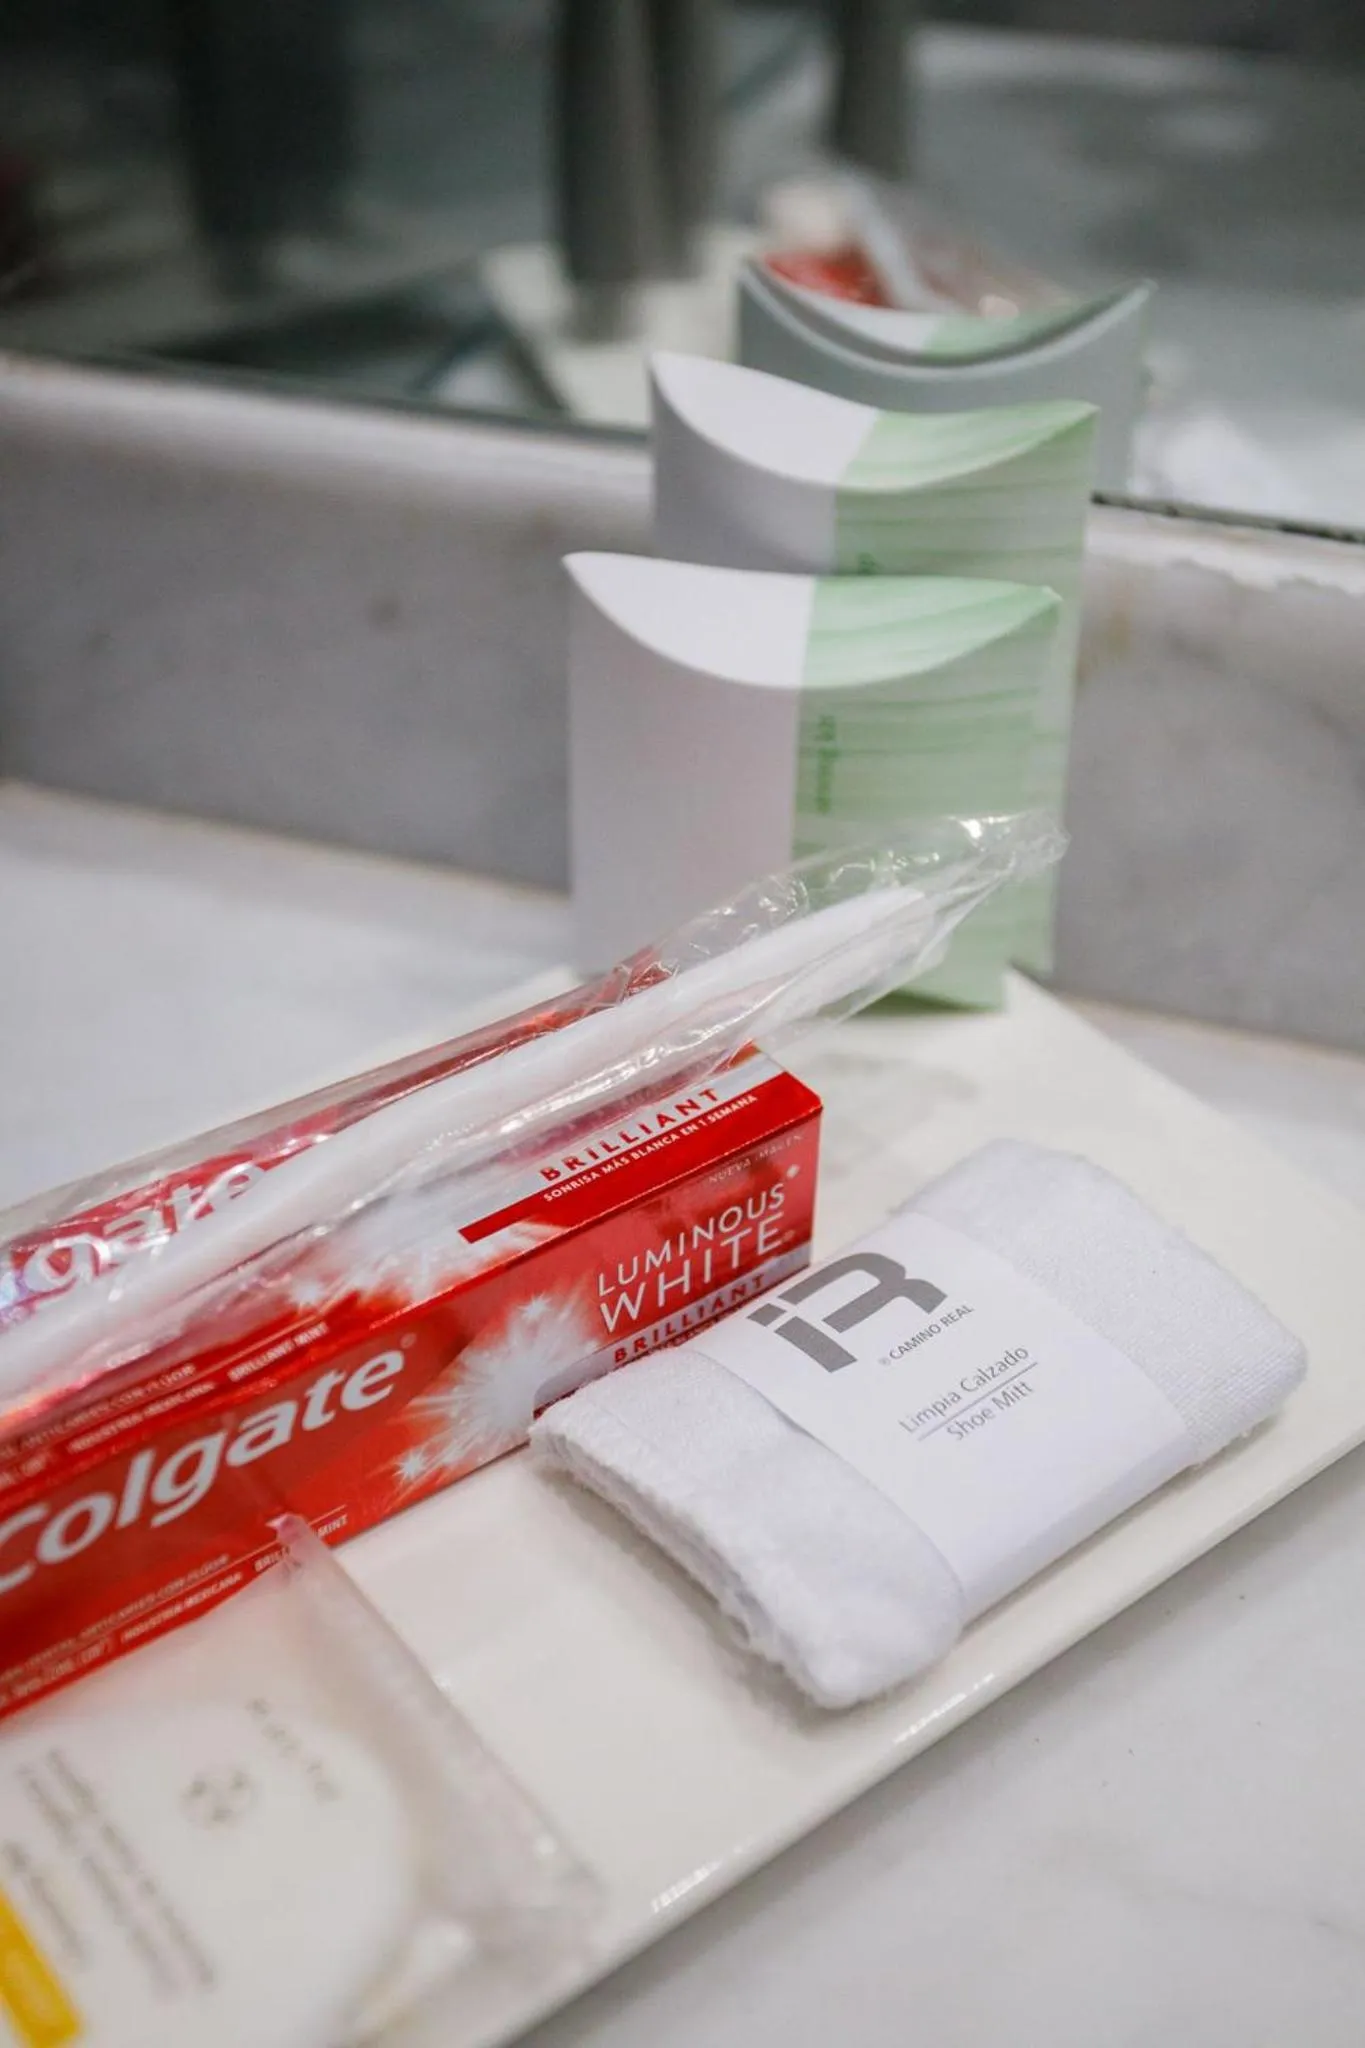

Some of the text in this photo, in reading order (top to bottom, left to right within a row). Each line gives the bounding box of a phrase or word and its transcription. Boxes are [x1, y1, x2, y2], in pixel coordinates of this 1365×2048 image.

[540, 1088, 718, 1182] BRILLIANT
[544, 1171, 602, 1202] SONRISA
[631, 1132, 680, 1161] BLANCA
[680, 1122, 700, 1137] EN
[708, 1094, 759, 1125] SEMANA
[598, 1182, 785, 1297] LUMINOUS
[600, 1212, 783, 1334] WHITE
[614, 1274, 766, 1363] BRILLIANT
[889, 1304, 976, 1360] CAMINO REAL
[898, 1347, 1029, 1434] Limpia Calzado
[947, 1381, 1034, 1441] Shoe Mitt
